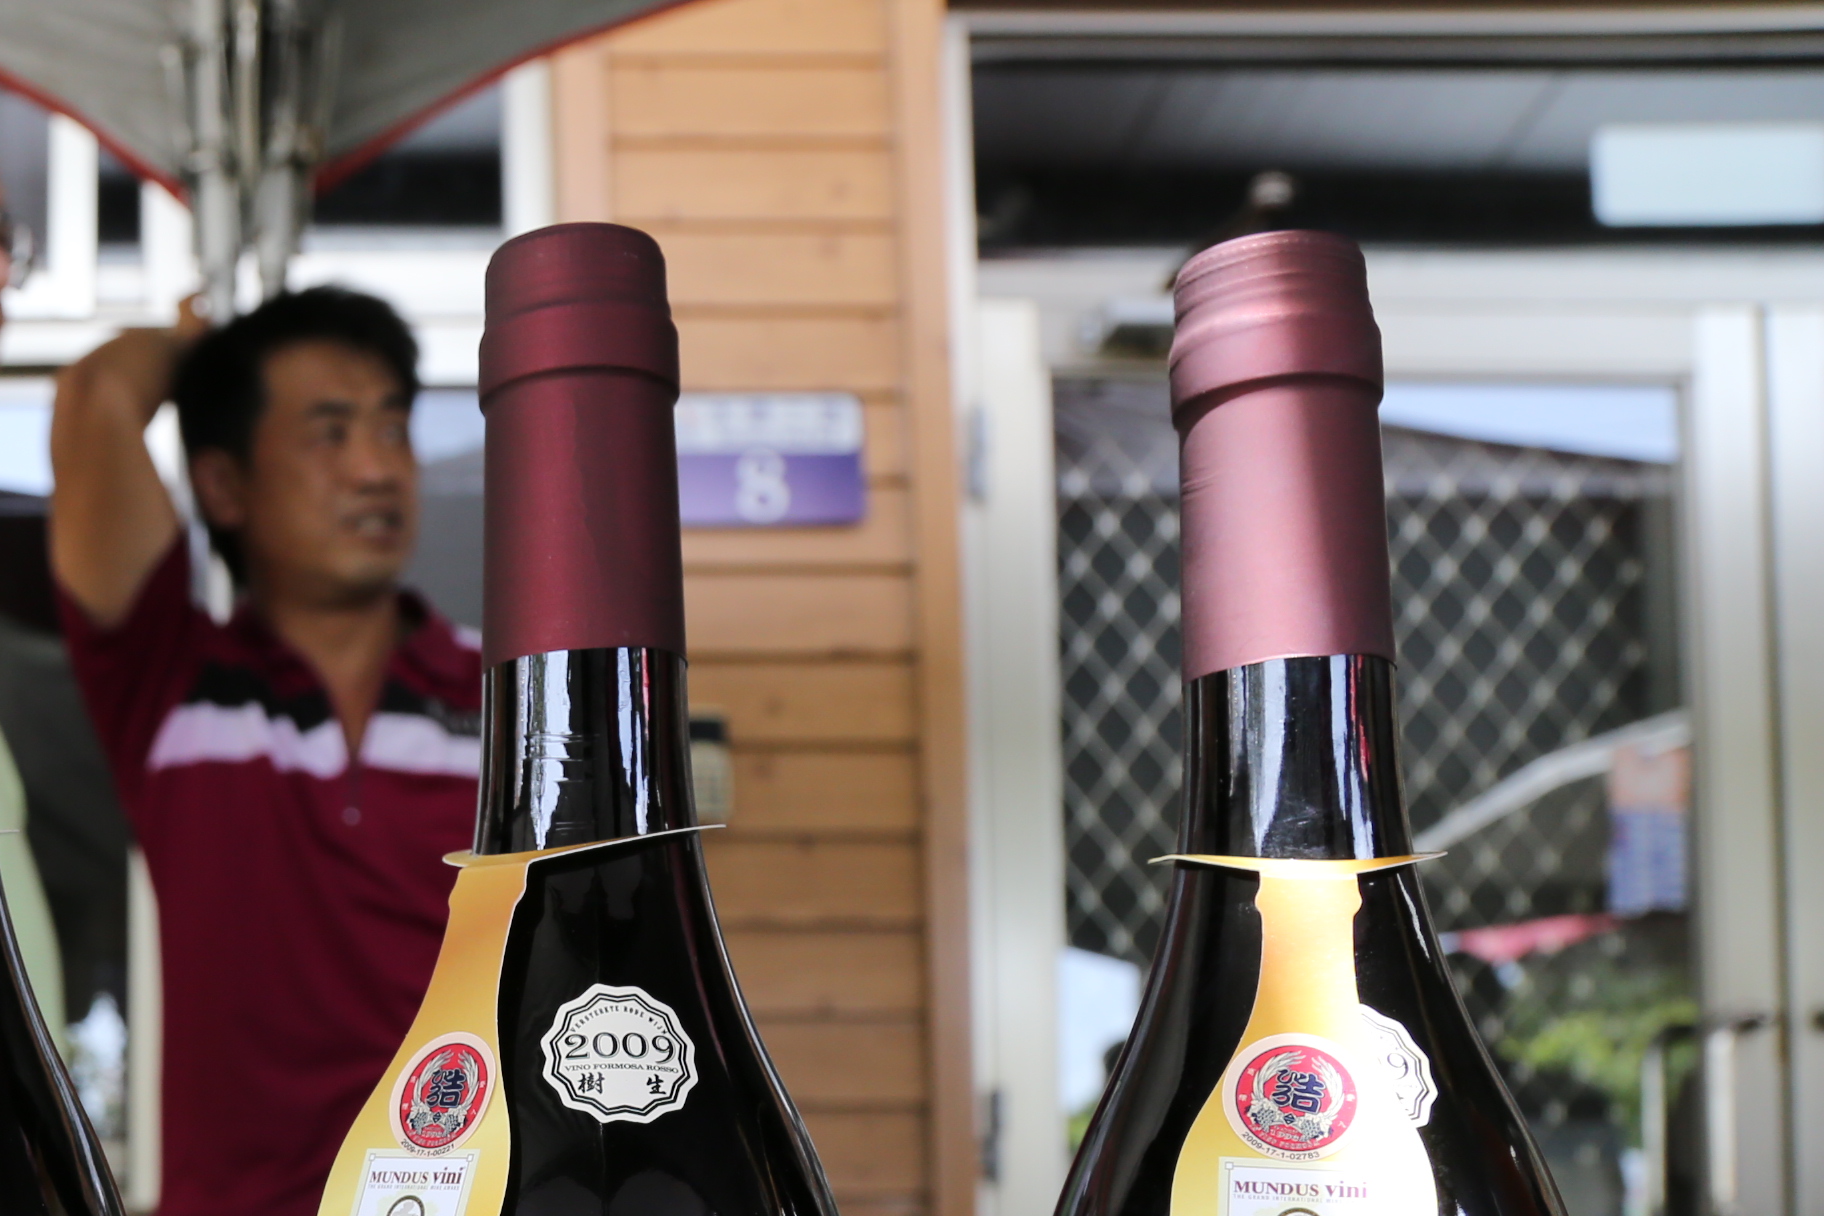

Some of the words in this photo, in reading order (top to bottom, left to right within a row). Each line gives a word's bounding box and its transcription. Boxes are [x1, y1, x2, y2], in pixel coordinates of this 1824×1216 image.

[735, 447, 790, 523] 8
[564, 1032, 676, 1064] 2009
[646, 1065, 678, 1073] ROSSO
[370, 1171, 428, 1184] MUNDUS
[433, 1167, 464, 1184] vini
[1234, 1180, 1319, 1196] MUNDUS
[1325, 1180, 1367, 1198] vini
